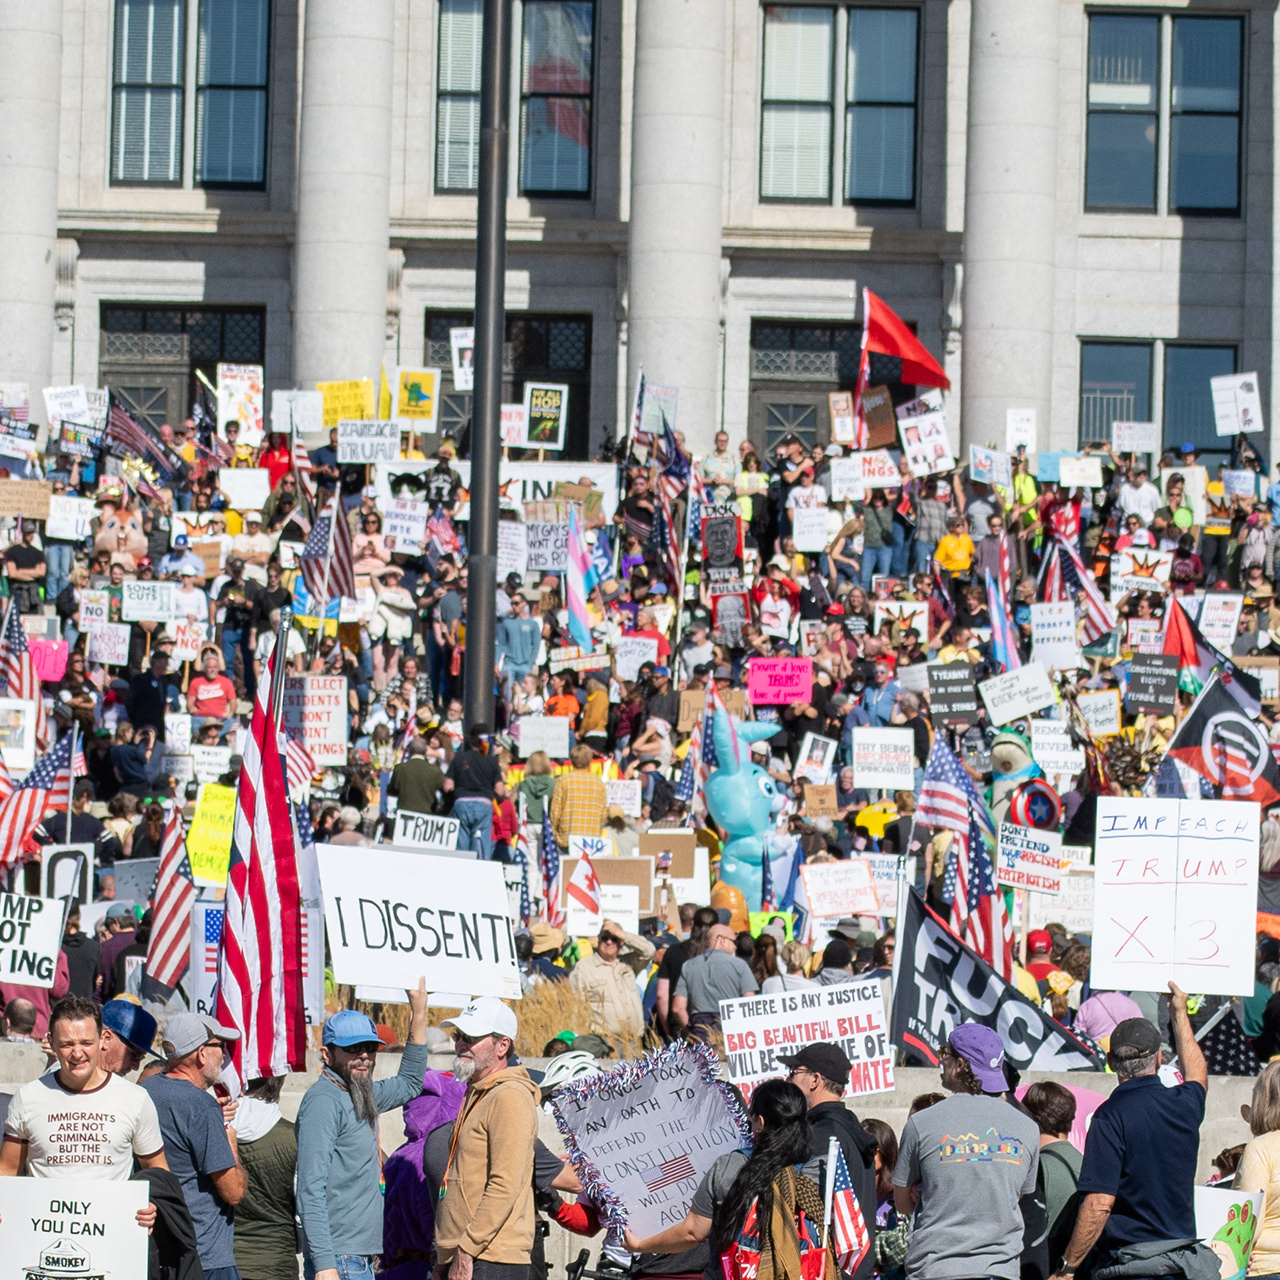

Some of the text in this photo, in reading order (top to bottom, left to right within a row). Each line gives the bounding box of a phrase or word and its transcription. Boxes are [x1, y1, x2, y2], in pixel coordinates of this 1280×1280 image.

[532, 398, 560, 408] HOP
[704, 506, 736, 517] DICK
[530, 553, 551, 567] HIS
[126, 584, 157, 592] SOME
[711, 585, 742, 593] BULLY
[129, 592, 157, 600] CUTS
[85, 606, 103, 617] NO
[932, 671, 970, 680] TYRANNY
[309, 680, 343, 690] ELECT
[310, 745, 345, 756] KINGS
[856, 744, 911, 753] TRY BEING
[856, 753, 911, 762] INFORMED
[856, 767, 911, 775] OPINIONATED
[400, 814, 458, 846] TRUMP
[1102, 815, 1248, 834] IMPEACH
[1001, 835, 1050, 854] PRETEND
[1020, 850, 1061, 870] RACISM
[1111, 858, 1249, 880] TRUMP
[998, 868, 1061, 892] PATRIOTISM
[335, 897, 518, 966] I DISSENT!
[1110, 916, 1221, 961] X 3
[721, 984, 881, 1021] IF THERE IS ANY JUSTICE
[761, 1018, 833, 1048] BEAUTIFUL
[727, 1034, 888, 1079] WILL BE OF
[647, 1063, 691, 1089] TOOK
[585, 1086, 695, 1134] AN OATH TO
[48, 1113, 117, 1124] IMMIGRANTS
[58, 1123, 105, 1133] ARE NOT
[49, 1133, 111, 1144] CRIMINALS,
[592, 1115, 687, 1159] DEFEND THE
[60, 1143, 100, 1153] BUT THE
[603, 1120, 739, 1180] CONSTITUTION
[945, 1141, 1019, 1158] patagonia
[47, 1155, 100, 1165] PRESIDENT
[637, 1176, 699, 1214] WILL DO
[49, 1199, 92, 1217] ONLY
[30, 1218, 106, 1237] YOU CAN
[44, 1255, 87, 1269] SMOKEY
